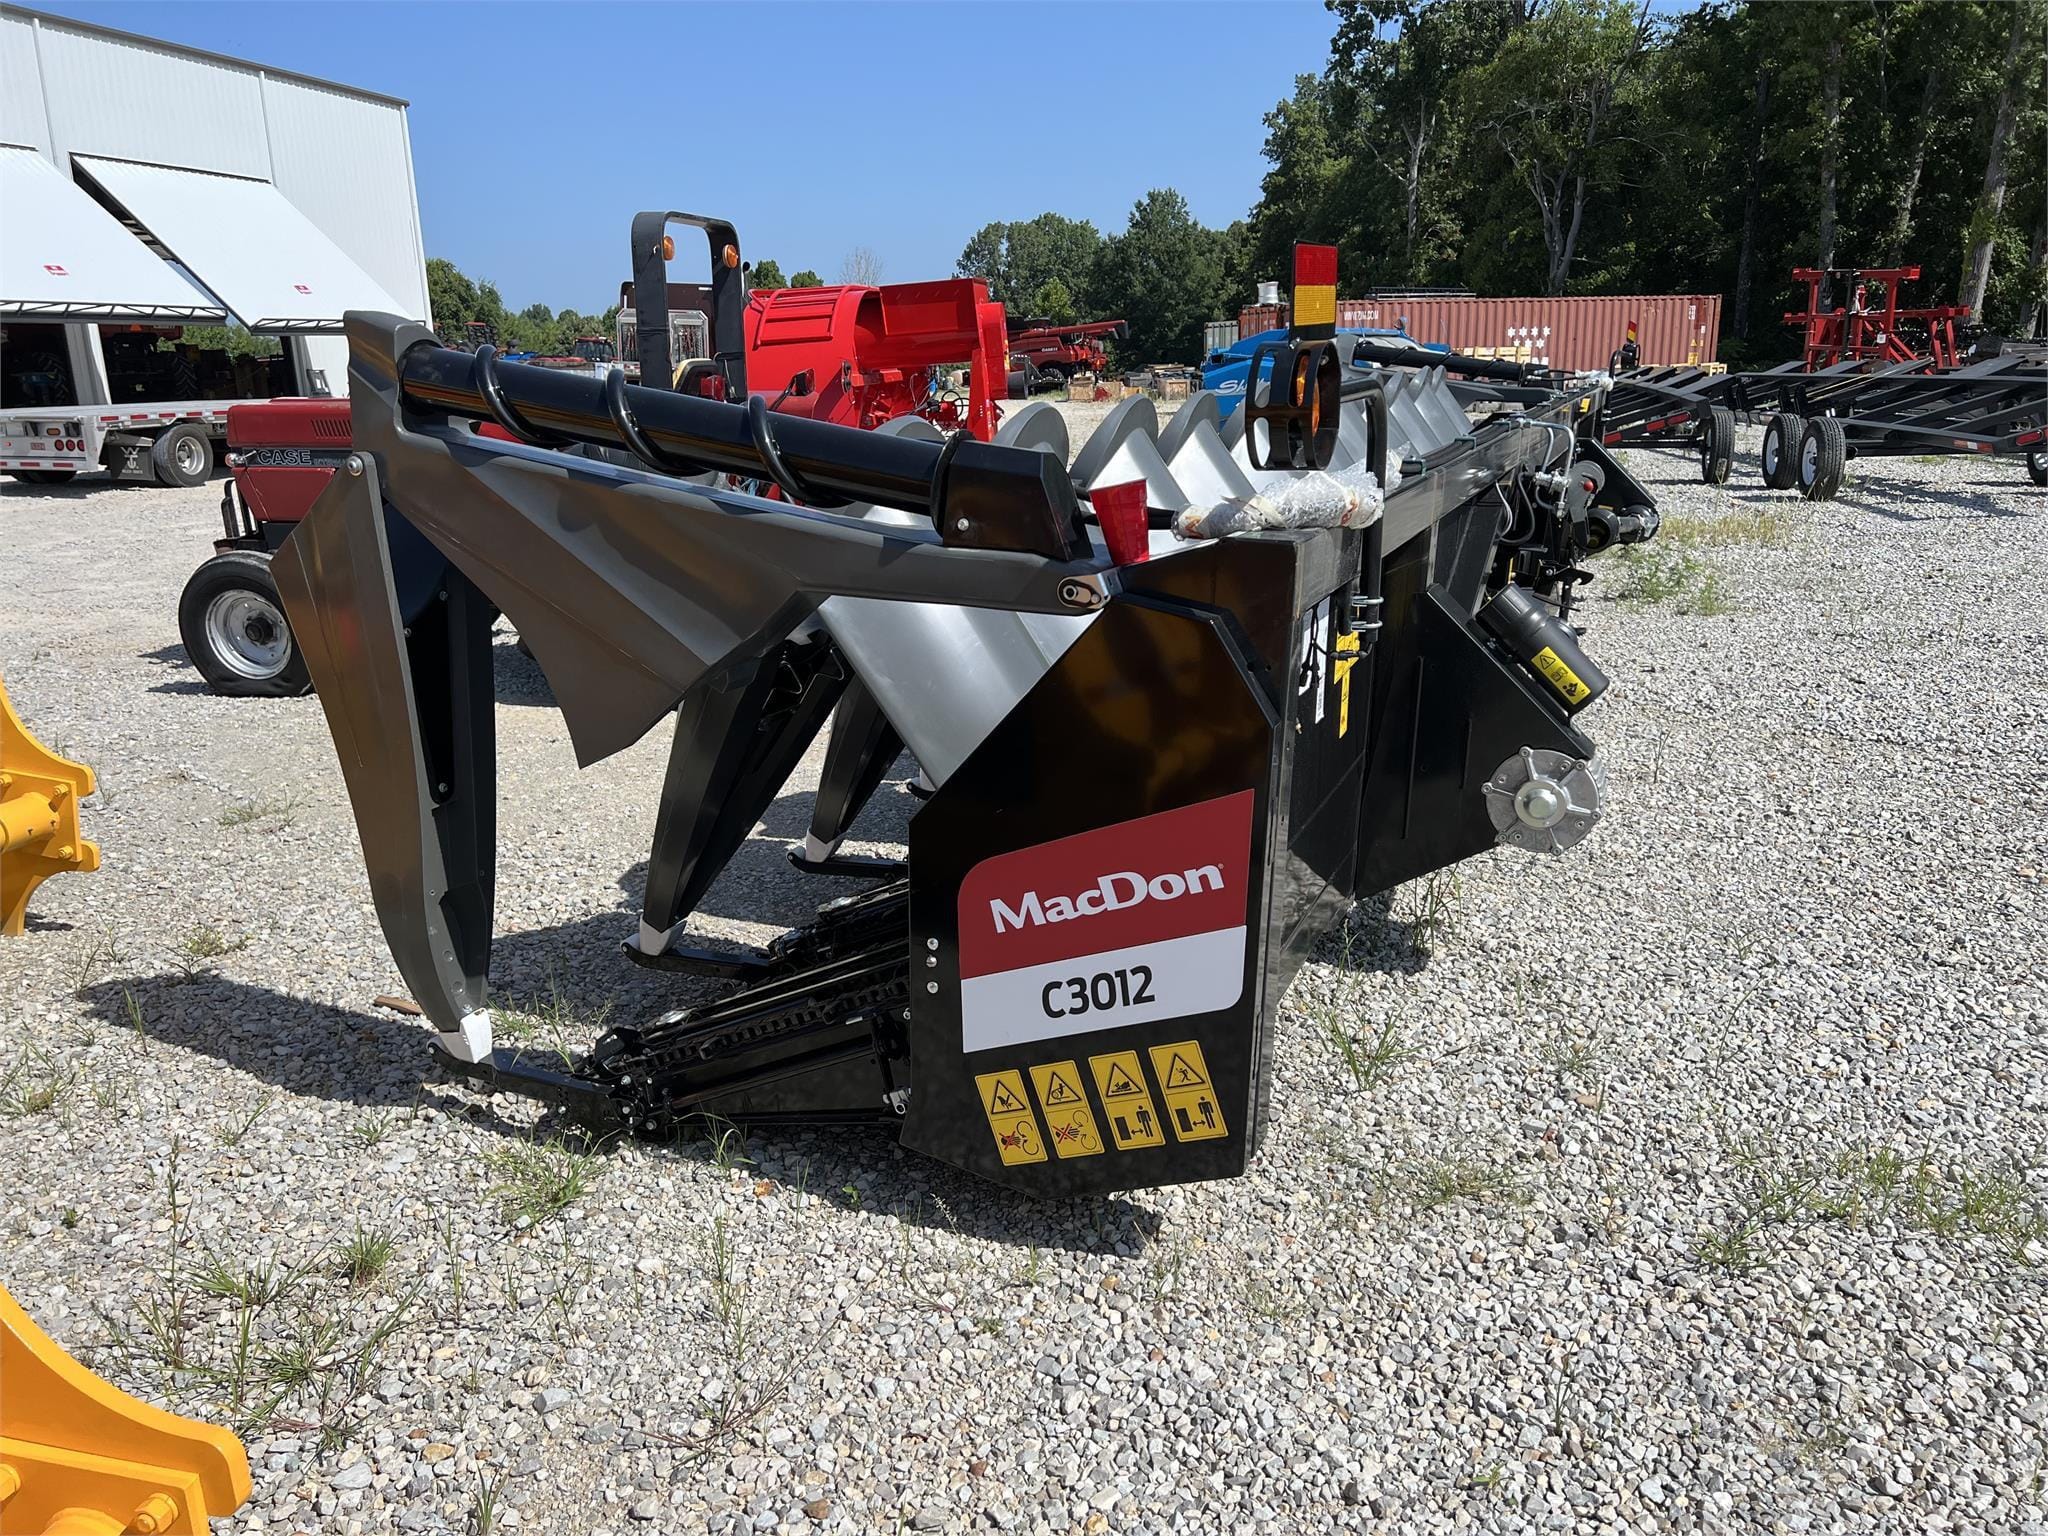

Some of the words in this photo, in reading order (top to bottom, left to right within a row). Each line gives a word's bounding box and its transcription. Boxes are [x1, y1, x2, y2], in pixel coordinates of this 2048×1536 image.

[258, 449, 312, 466] CASE
[988, 864, 1225, 934] MacDon
[1041, 964, 1156, 1019] C3012
